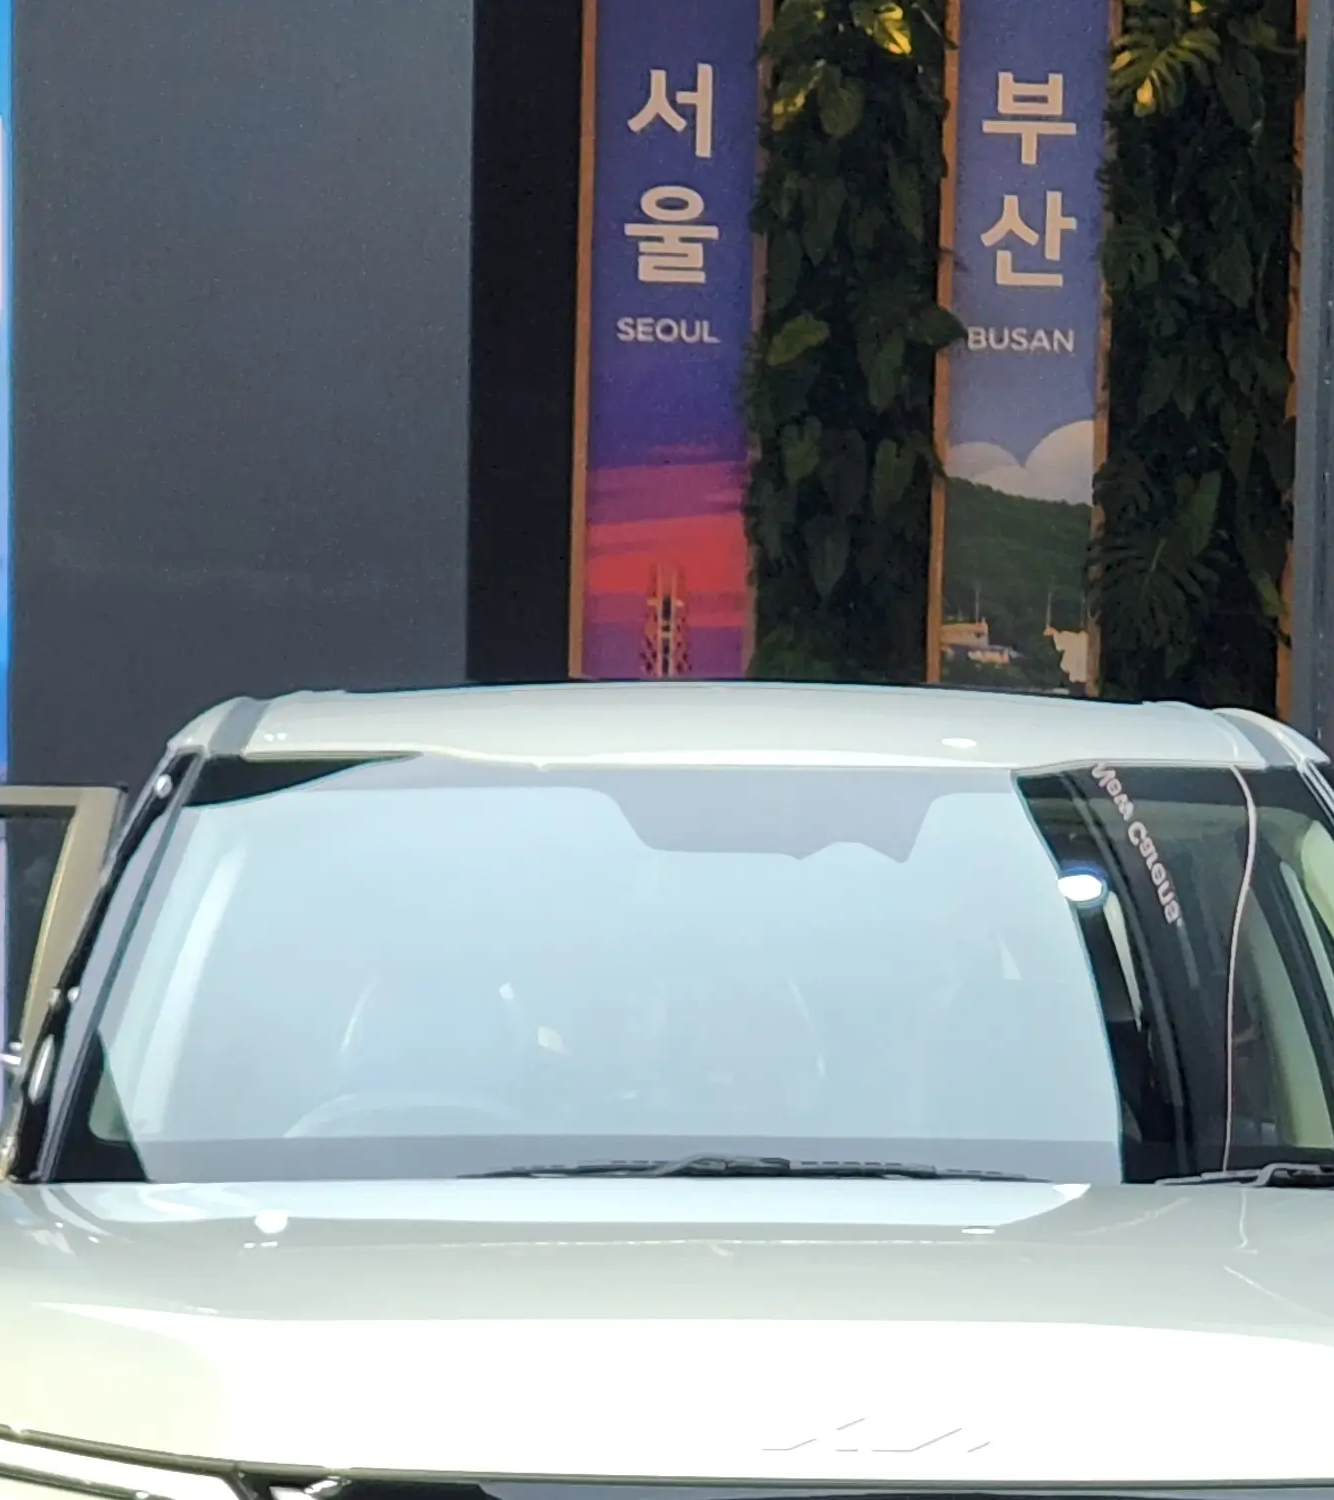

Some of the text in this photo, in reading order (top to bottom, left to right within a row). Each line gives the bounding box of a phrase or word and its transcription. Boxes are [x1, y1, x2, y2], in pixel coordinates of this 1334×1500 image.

[624, 63, 719, 284] 서울
[981, 71, 1076, 288] 부산
[617, 317, 720, 343] SEOUL
[967, 326, 1075, 353] BUSAN
